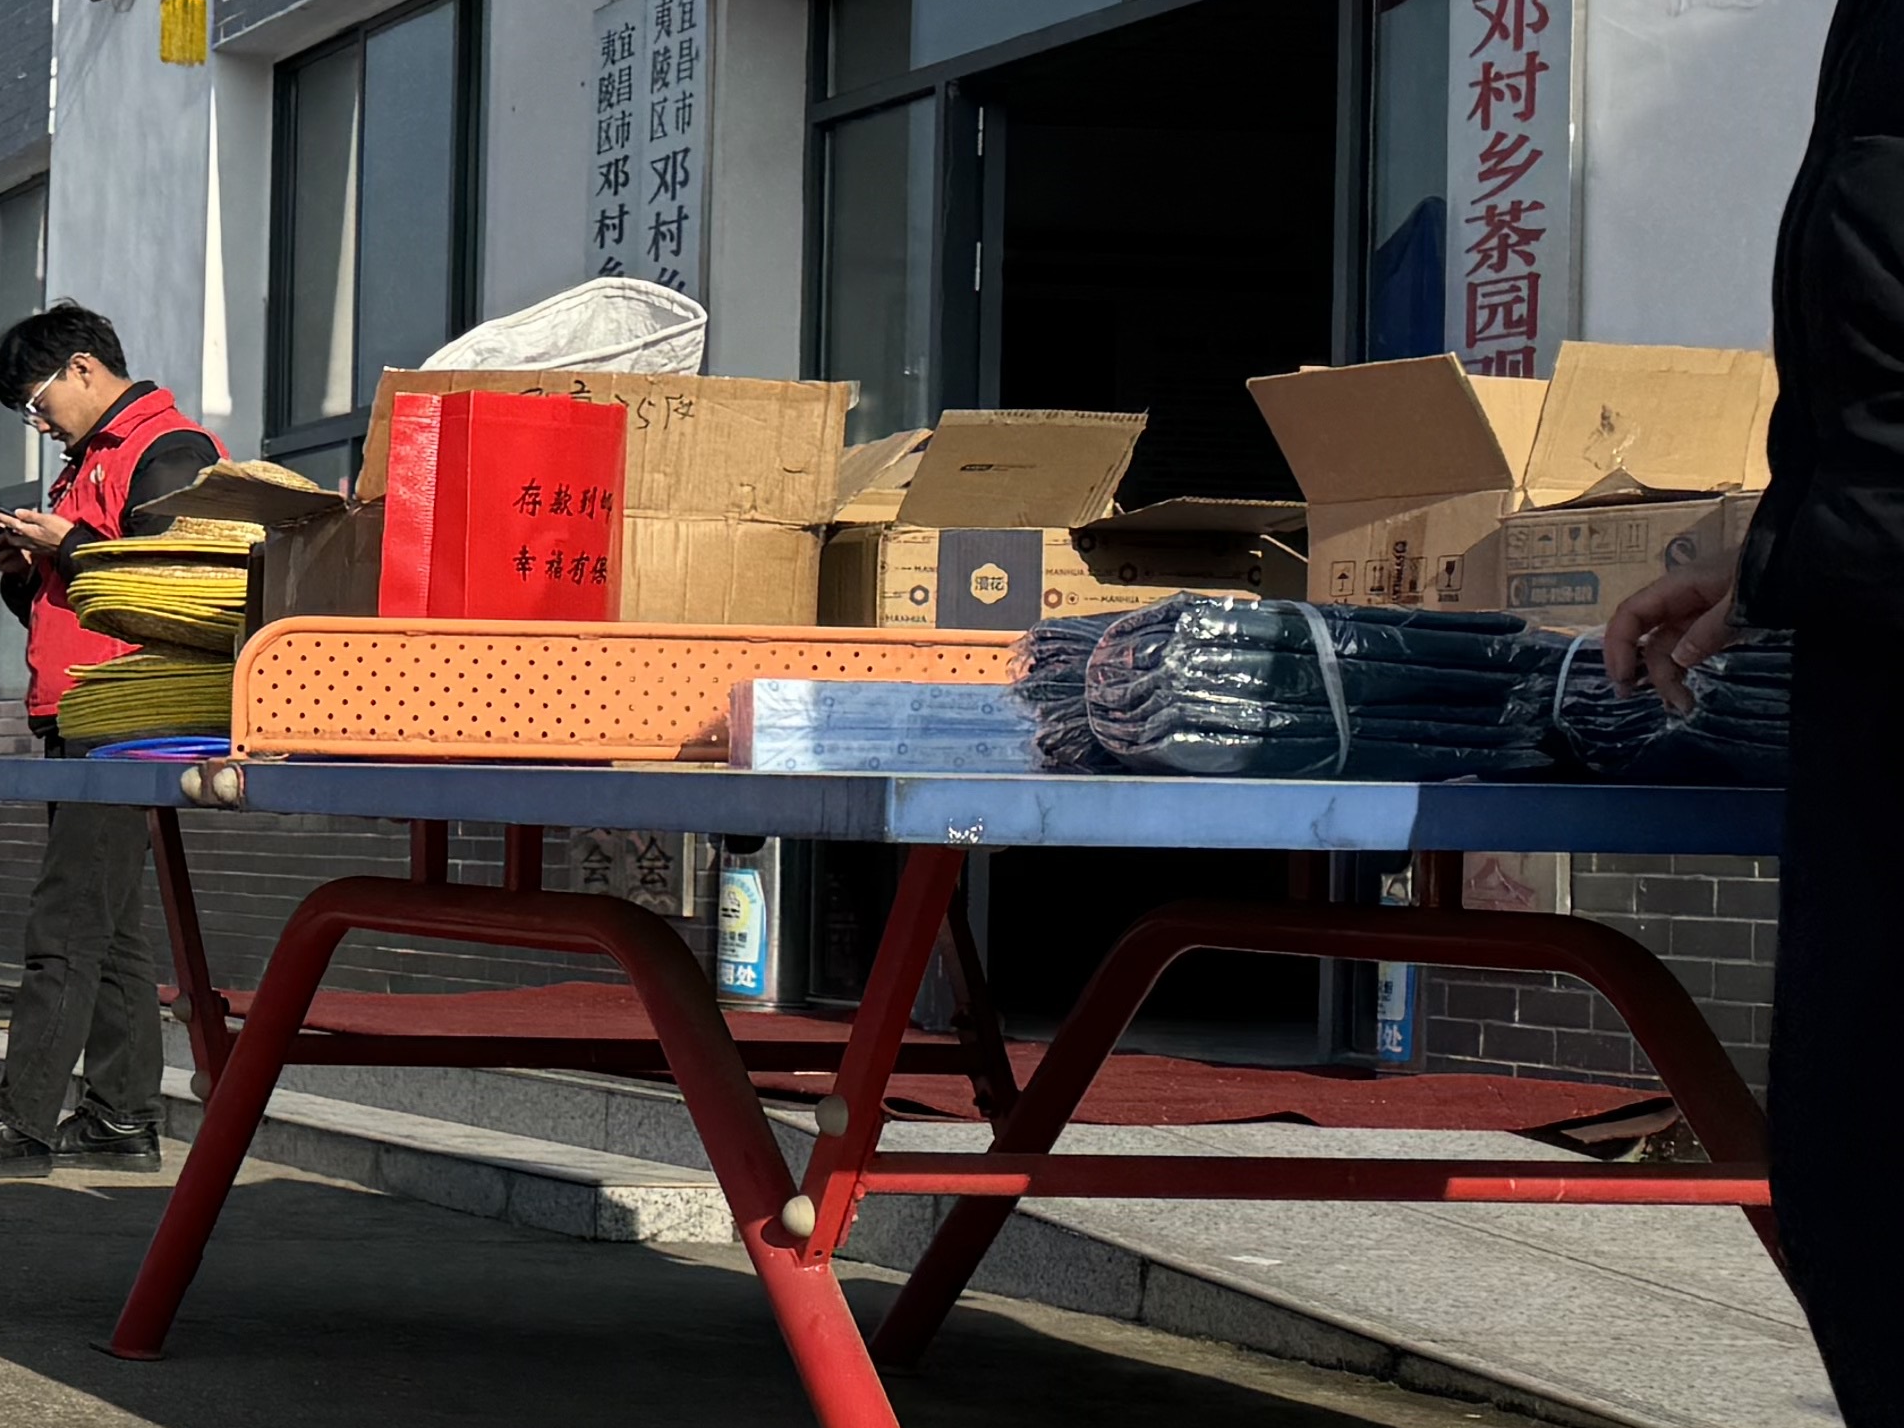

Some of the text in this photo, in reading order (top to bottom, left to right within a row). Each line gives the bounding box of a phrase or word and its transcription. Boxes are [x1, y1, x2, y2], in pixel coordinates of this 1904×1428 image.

[596, 29, 616, 156] 夷陵区
[613, 22, 636, 149] 宜昌市
